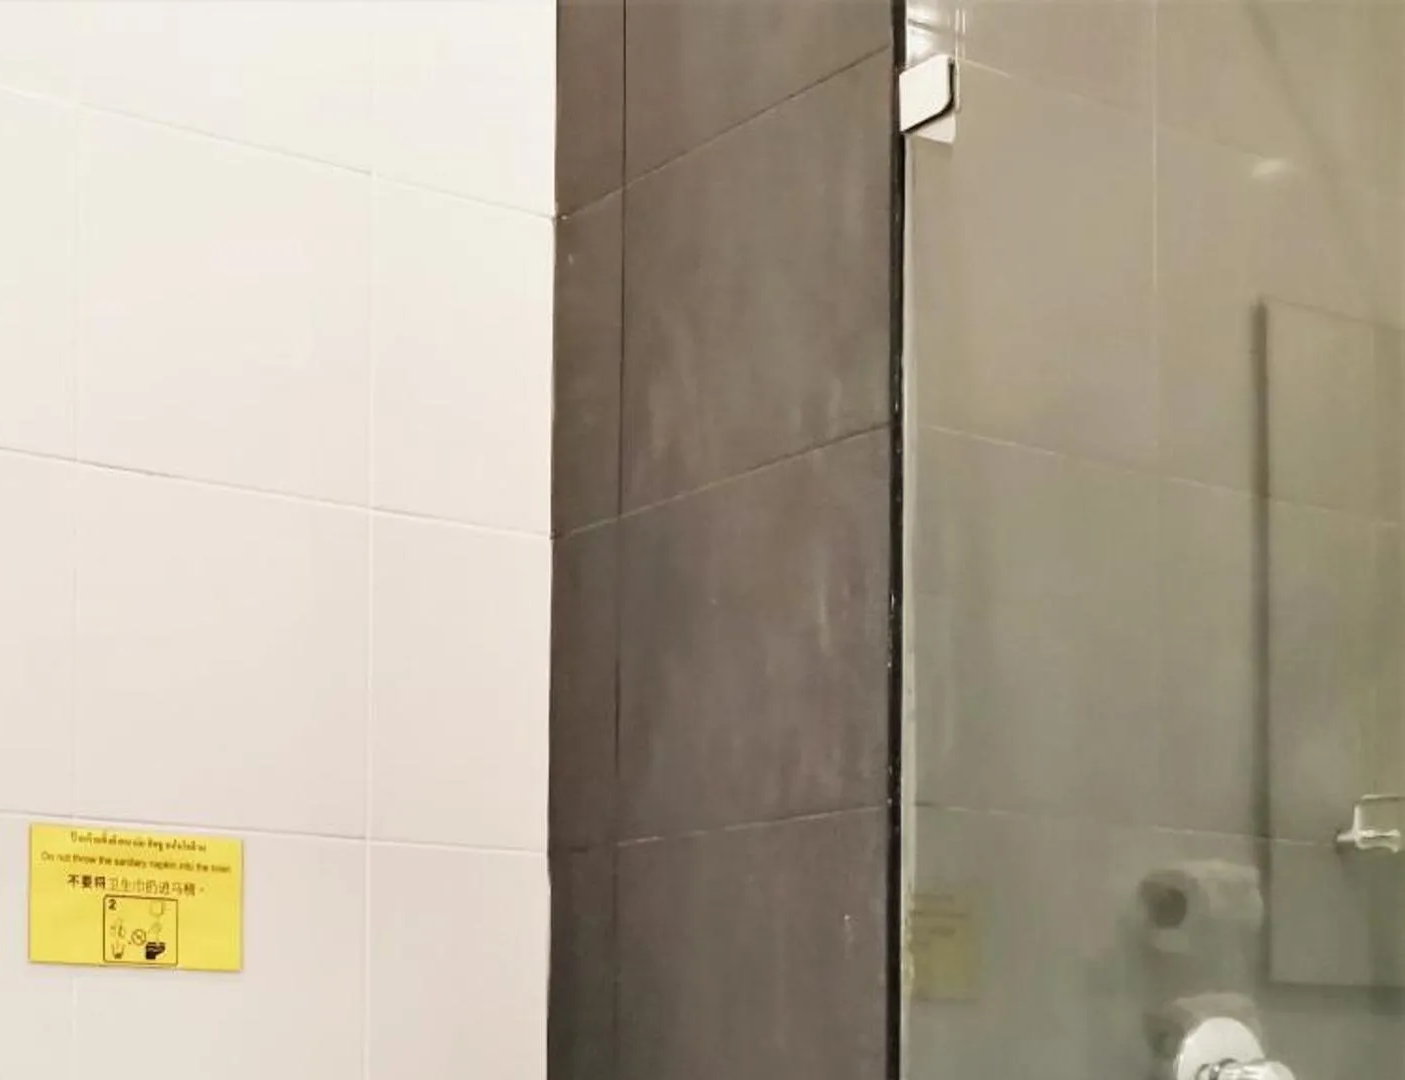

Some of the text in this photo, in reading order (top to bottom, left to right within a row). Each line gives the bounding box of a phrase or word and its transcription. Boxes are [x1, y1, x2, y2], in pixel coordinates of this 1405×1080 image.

[73, 854, 96, 864] throw
[98, 856, 112, 866] the
[195, 862, 209, 872] the
[108, 899, 117, 910] 2
